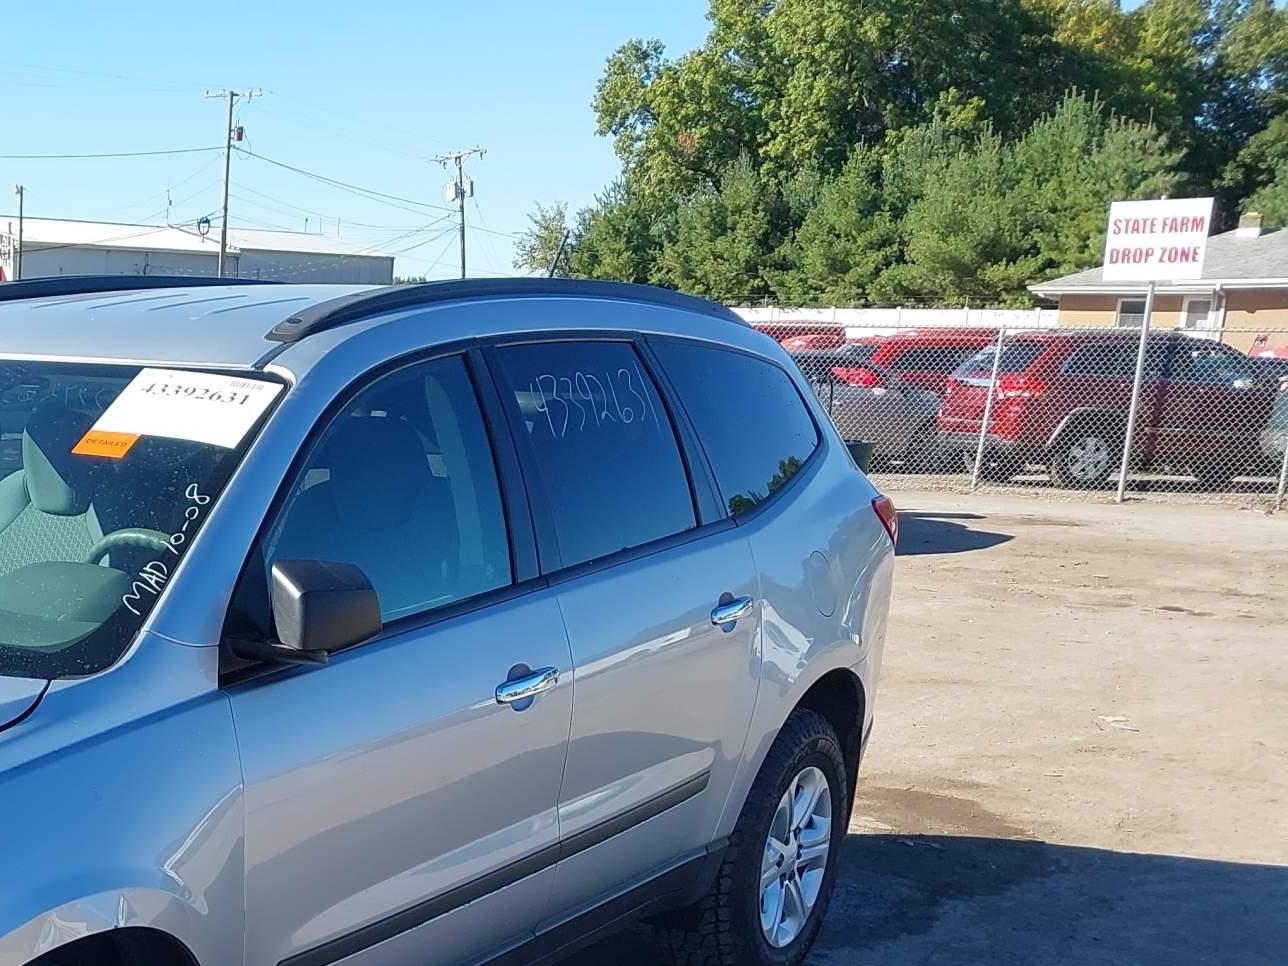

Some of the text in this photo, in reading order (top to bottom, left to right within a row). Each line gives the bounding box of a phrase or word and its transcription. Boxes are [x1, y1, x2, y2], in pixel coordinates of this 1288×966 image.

[1112, 216, 1206, 235] STATE FARM
[1109, 246, 1201, 264] DROP ZONE
[141, 383, 250, 405] 43392631
[523, 360, 661, 438] 43392631
[85, 438, 128, 448] DETAILED
[122, 482, 211, 616] MAD 10-08
